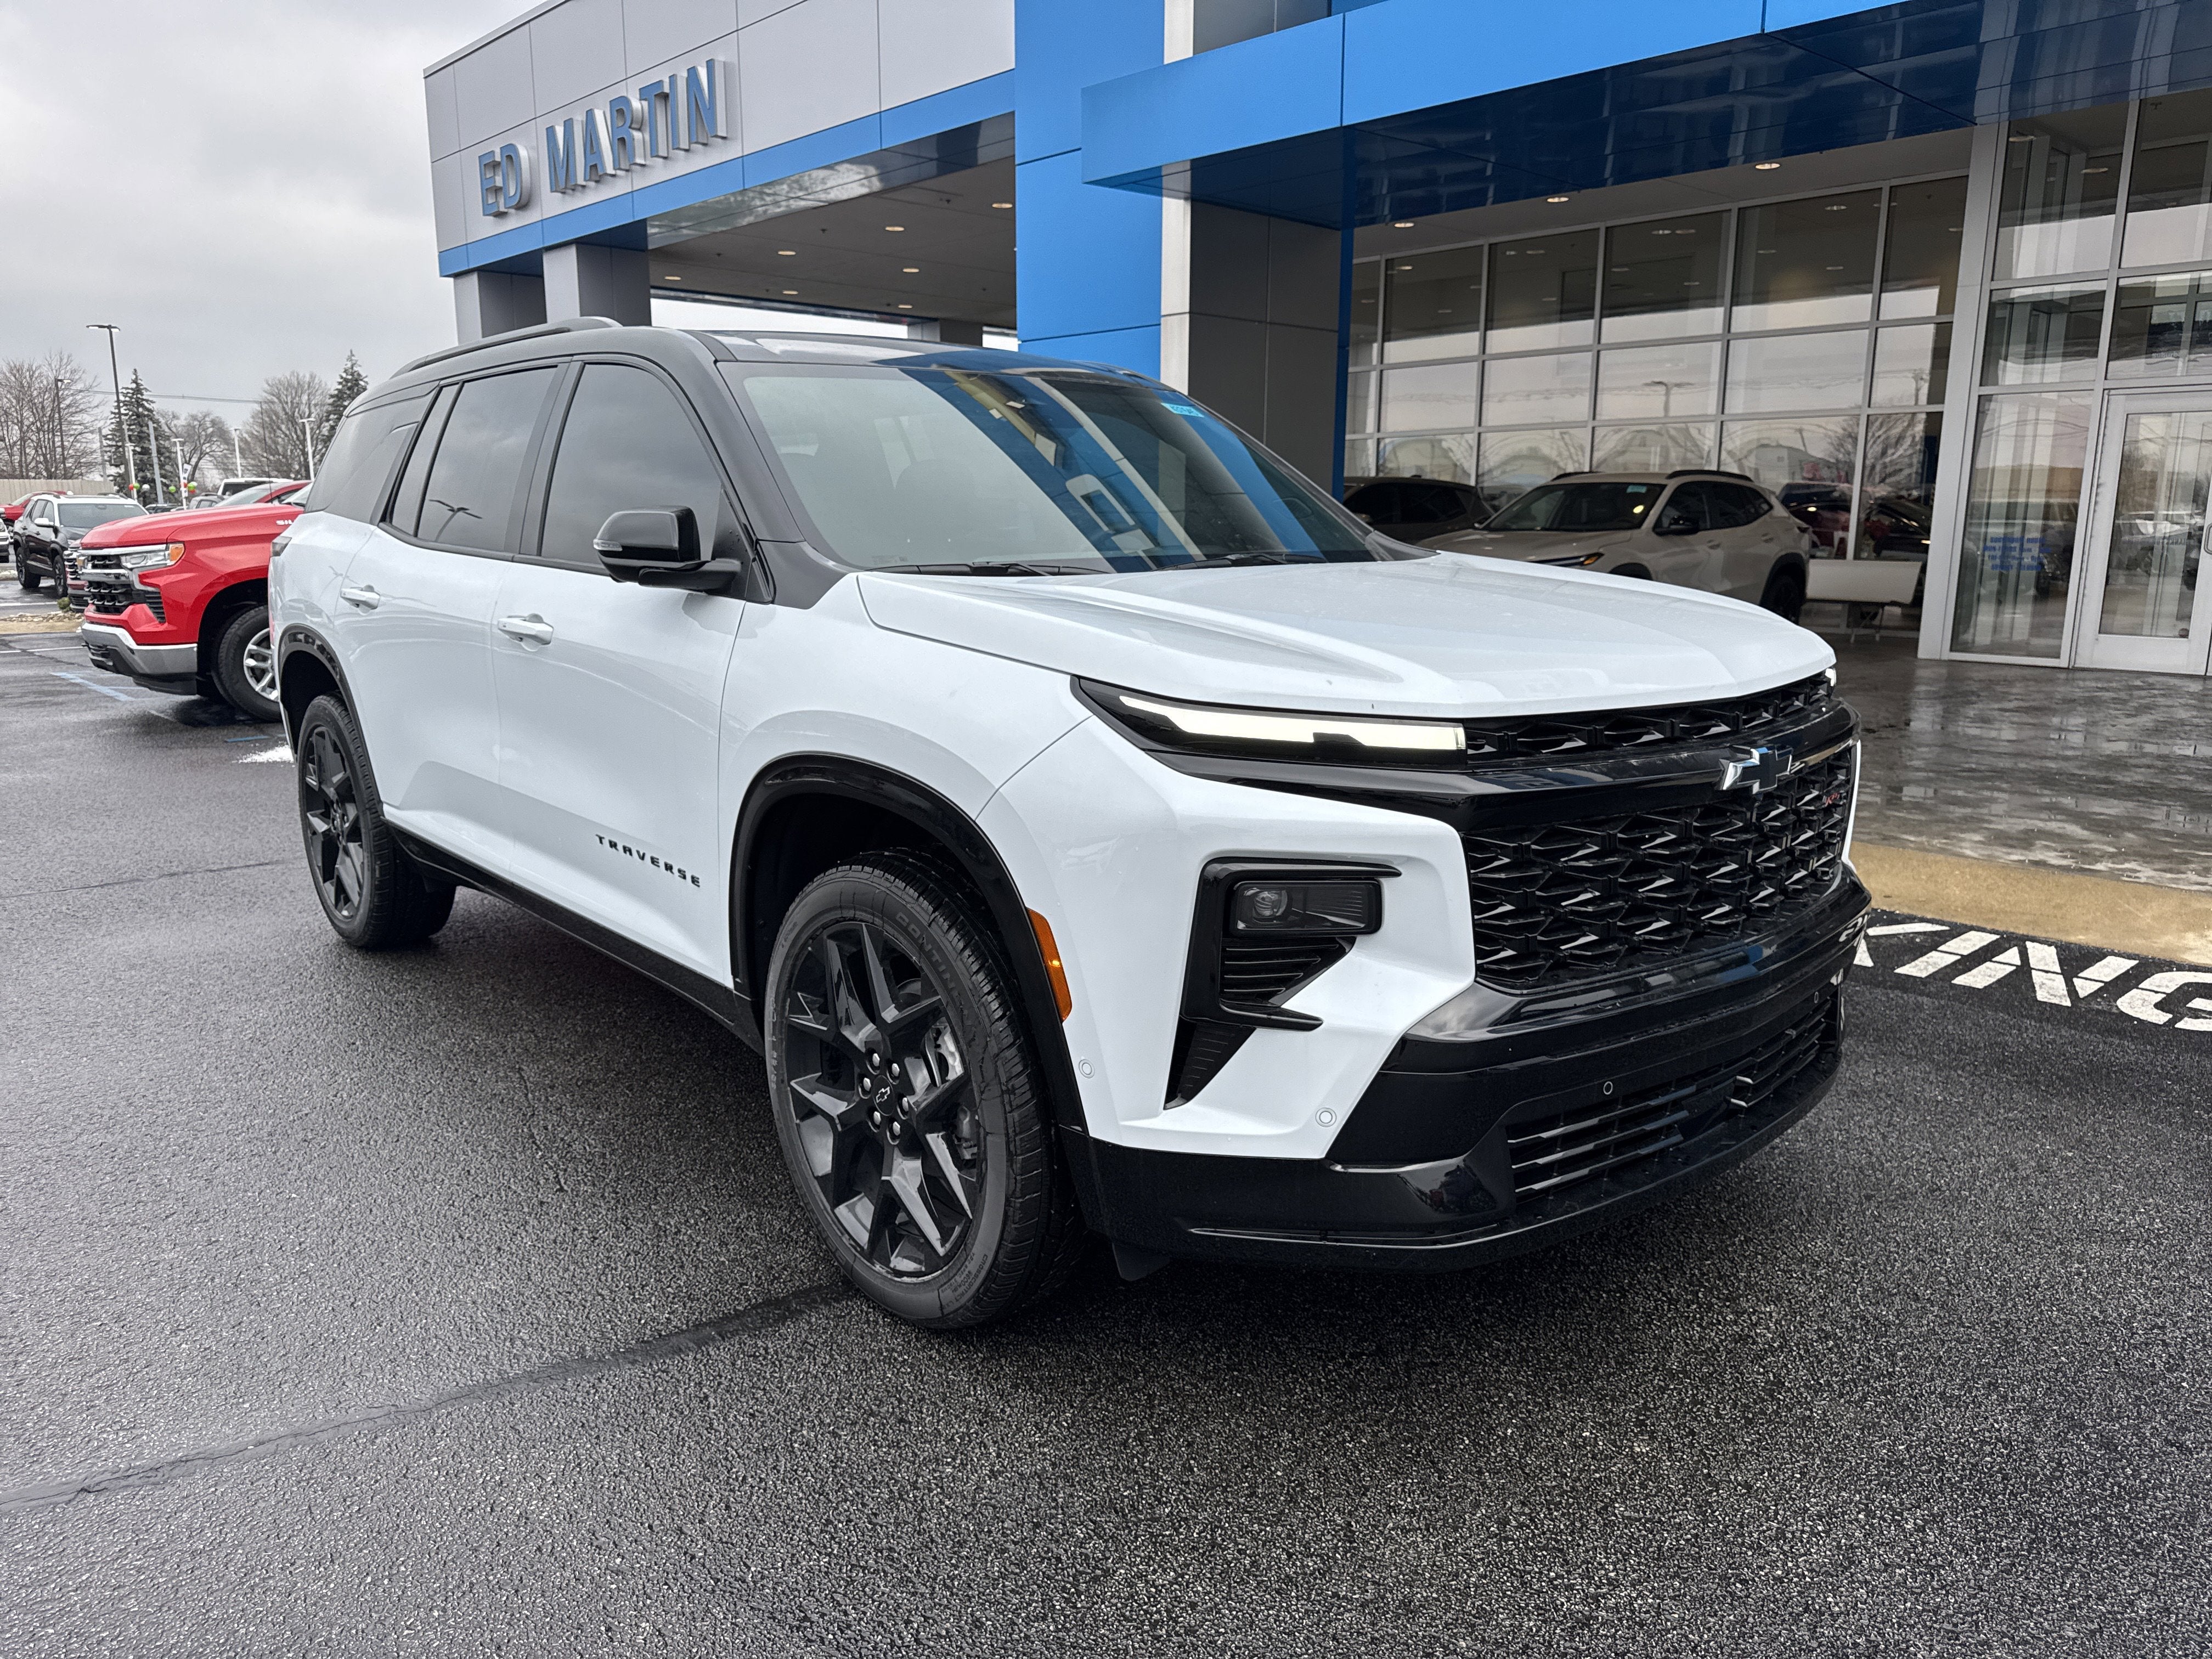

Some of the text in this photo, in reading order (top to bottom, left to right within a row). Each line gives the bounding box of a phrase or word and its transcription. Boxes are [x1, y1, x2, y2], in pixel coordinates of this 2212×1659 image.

[478, 58, 727, 216] ED MARTIN
[595, 833, 700, 888] TRAVERSE
